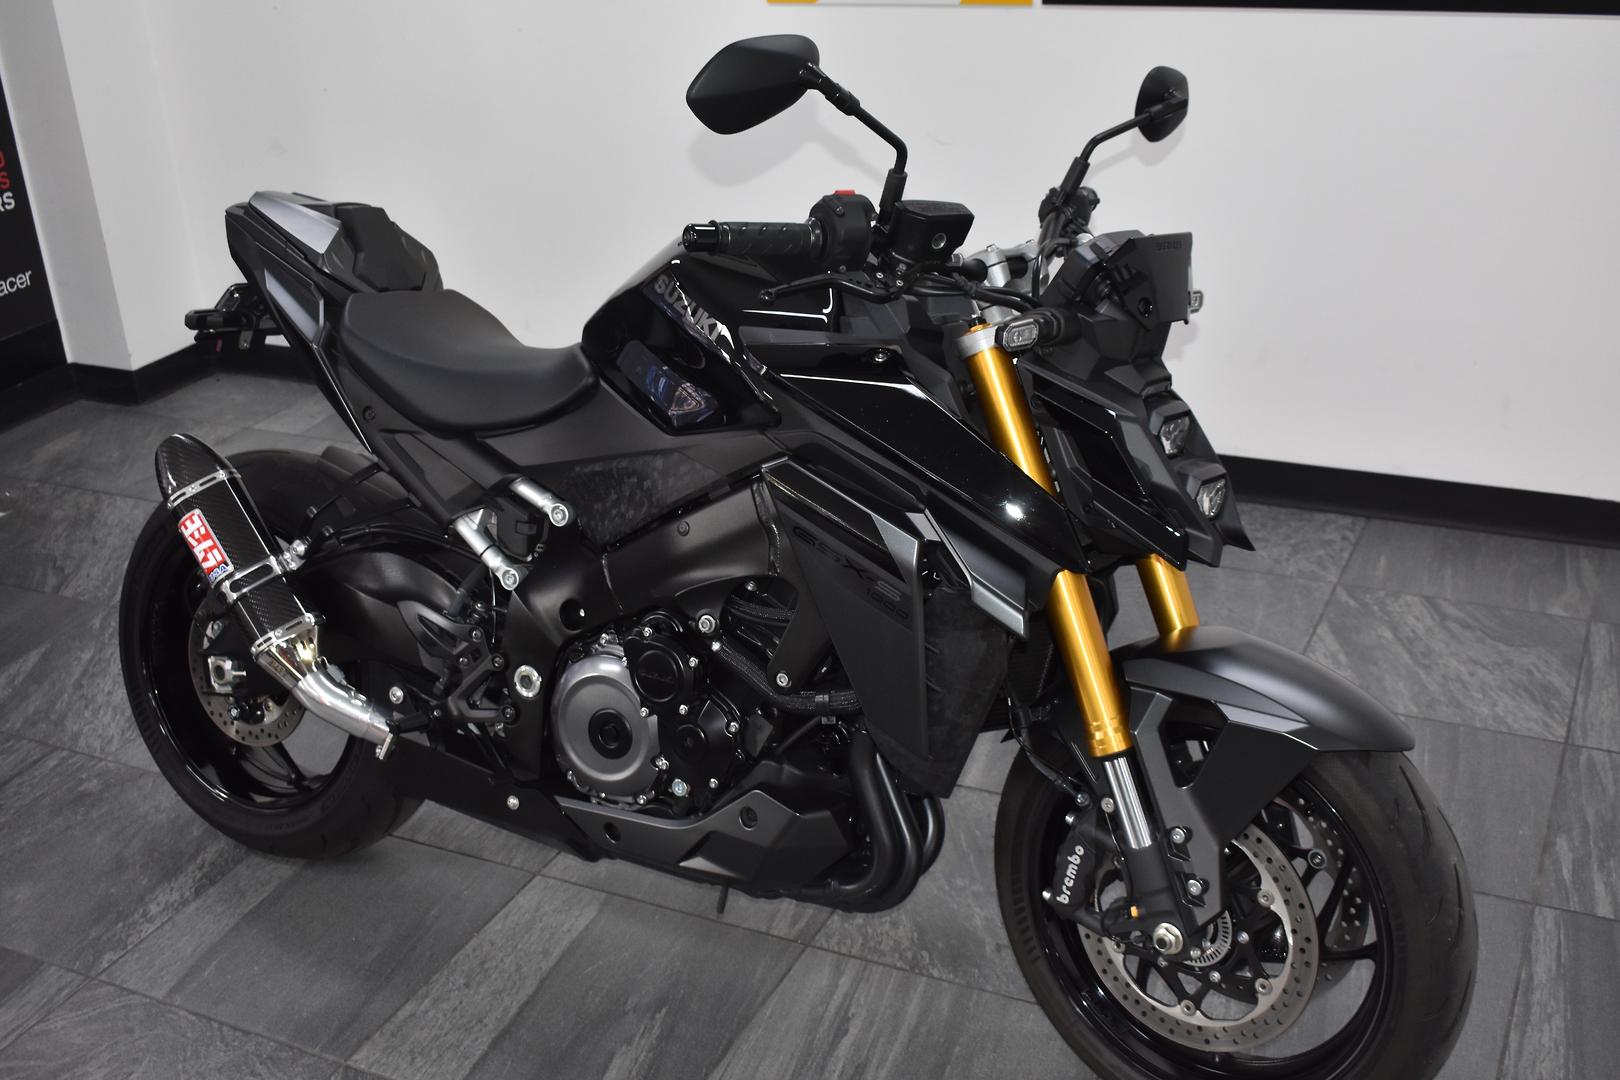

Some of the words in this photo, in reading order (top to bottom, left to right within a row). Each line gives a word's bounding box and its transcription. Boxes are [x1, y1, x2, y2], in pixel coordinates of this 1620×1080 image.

[654, 274, 724, 342] SUZUKI
[793, 526, 902, 601] GSX-S
[865, 587, 910, 620] 1000
[1056, 845, 1084, 904] brembo
